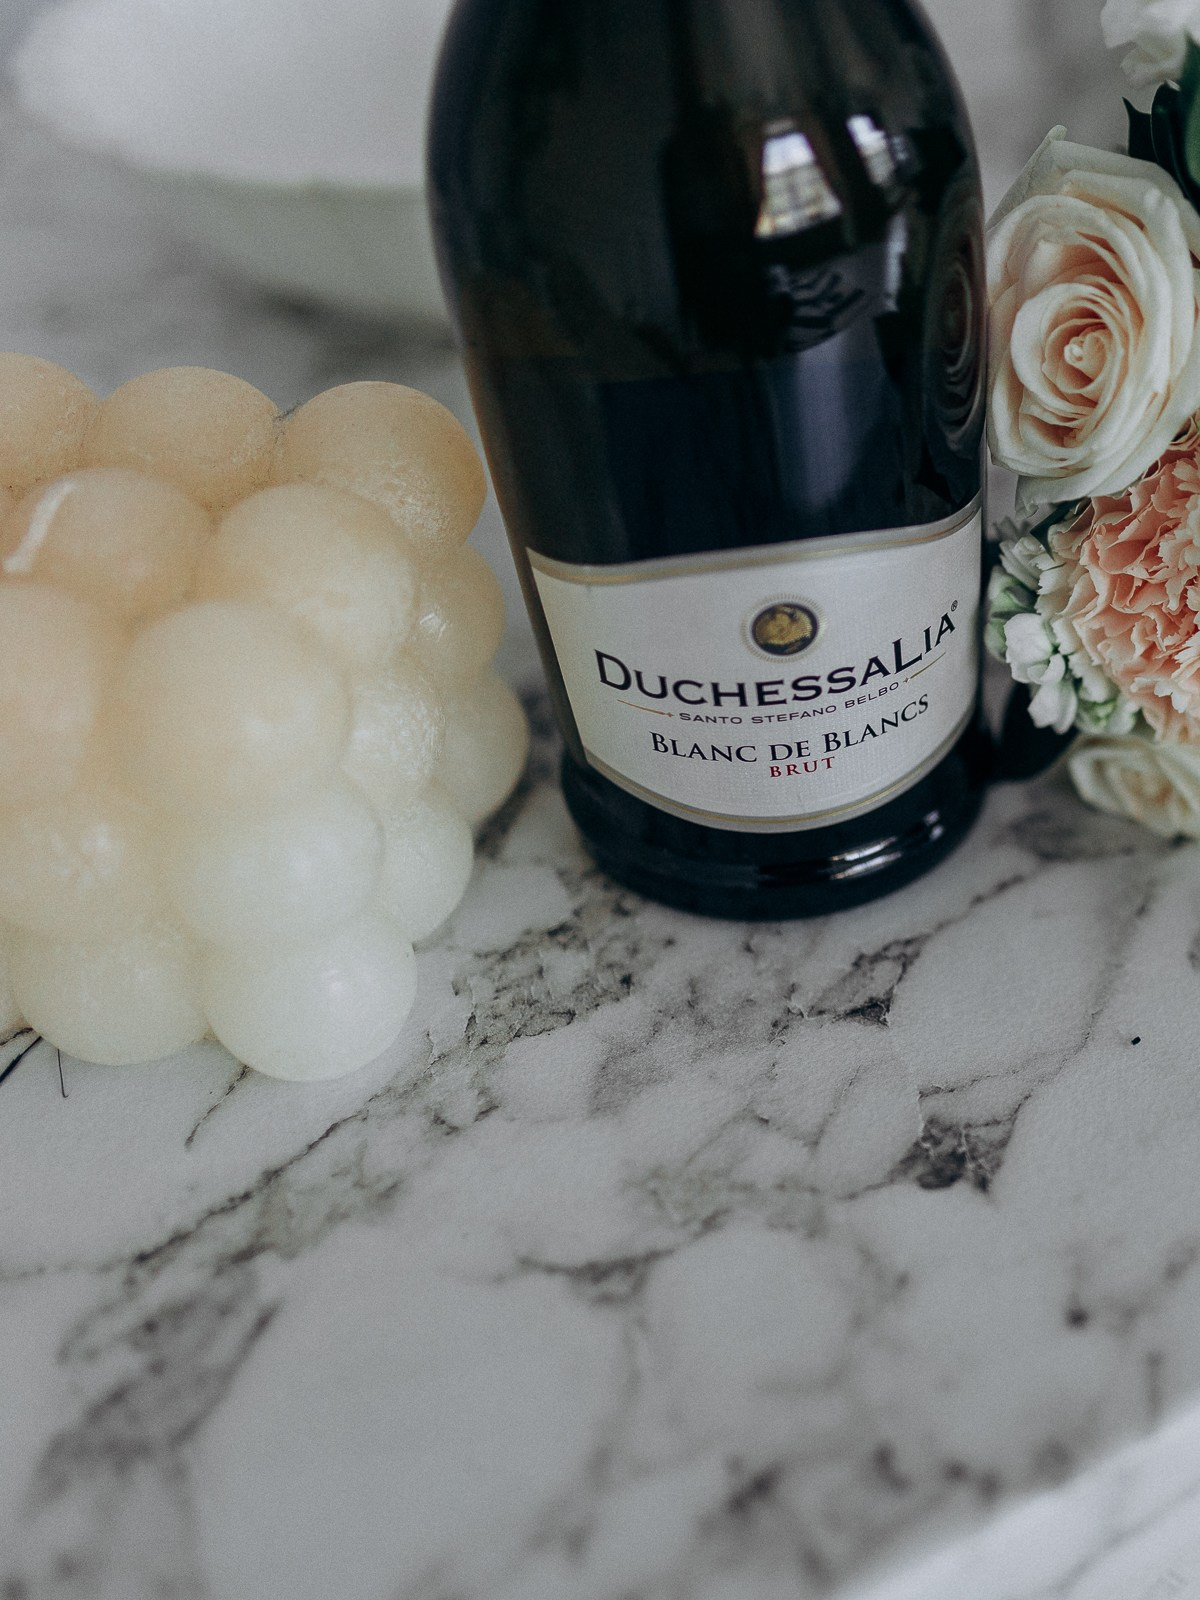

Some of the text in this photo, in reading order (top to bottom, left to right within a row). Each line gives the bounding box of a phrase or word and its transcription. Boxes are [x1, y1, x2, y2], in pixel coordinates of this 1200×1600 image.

[679, 682, 899, 725] SANTO STEFANO BELBO
[650, 693, 929, 763] BLANC DE BLANCS
[769, 756, 836, 778] BRUT
